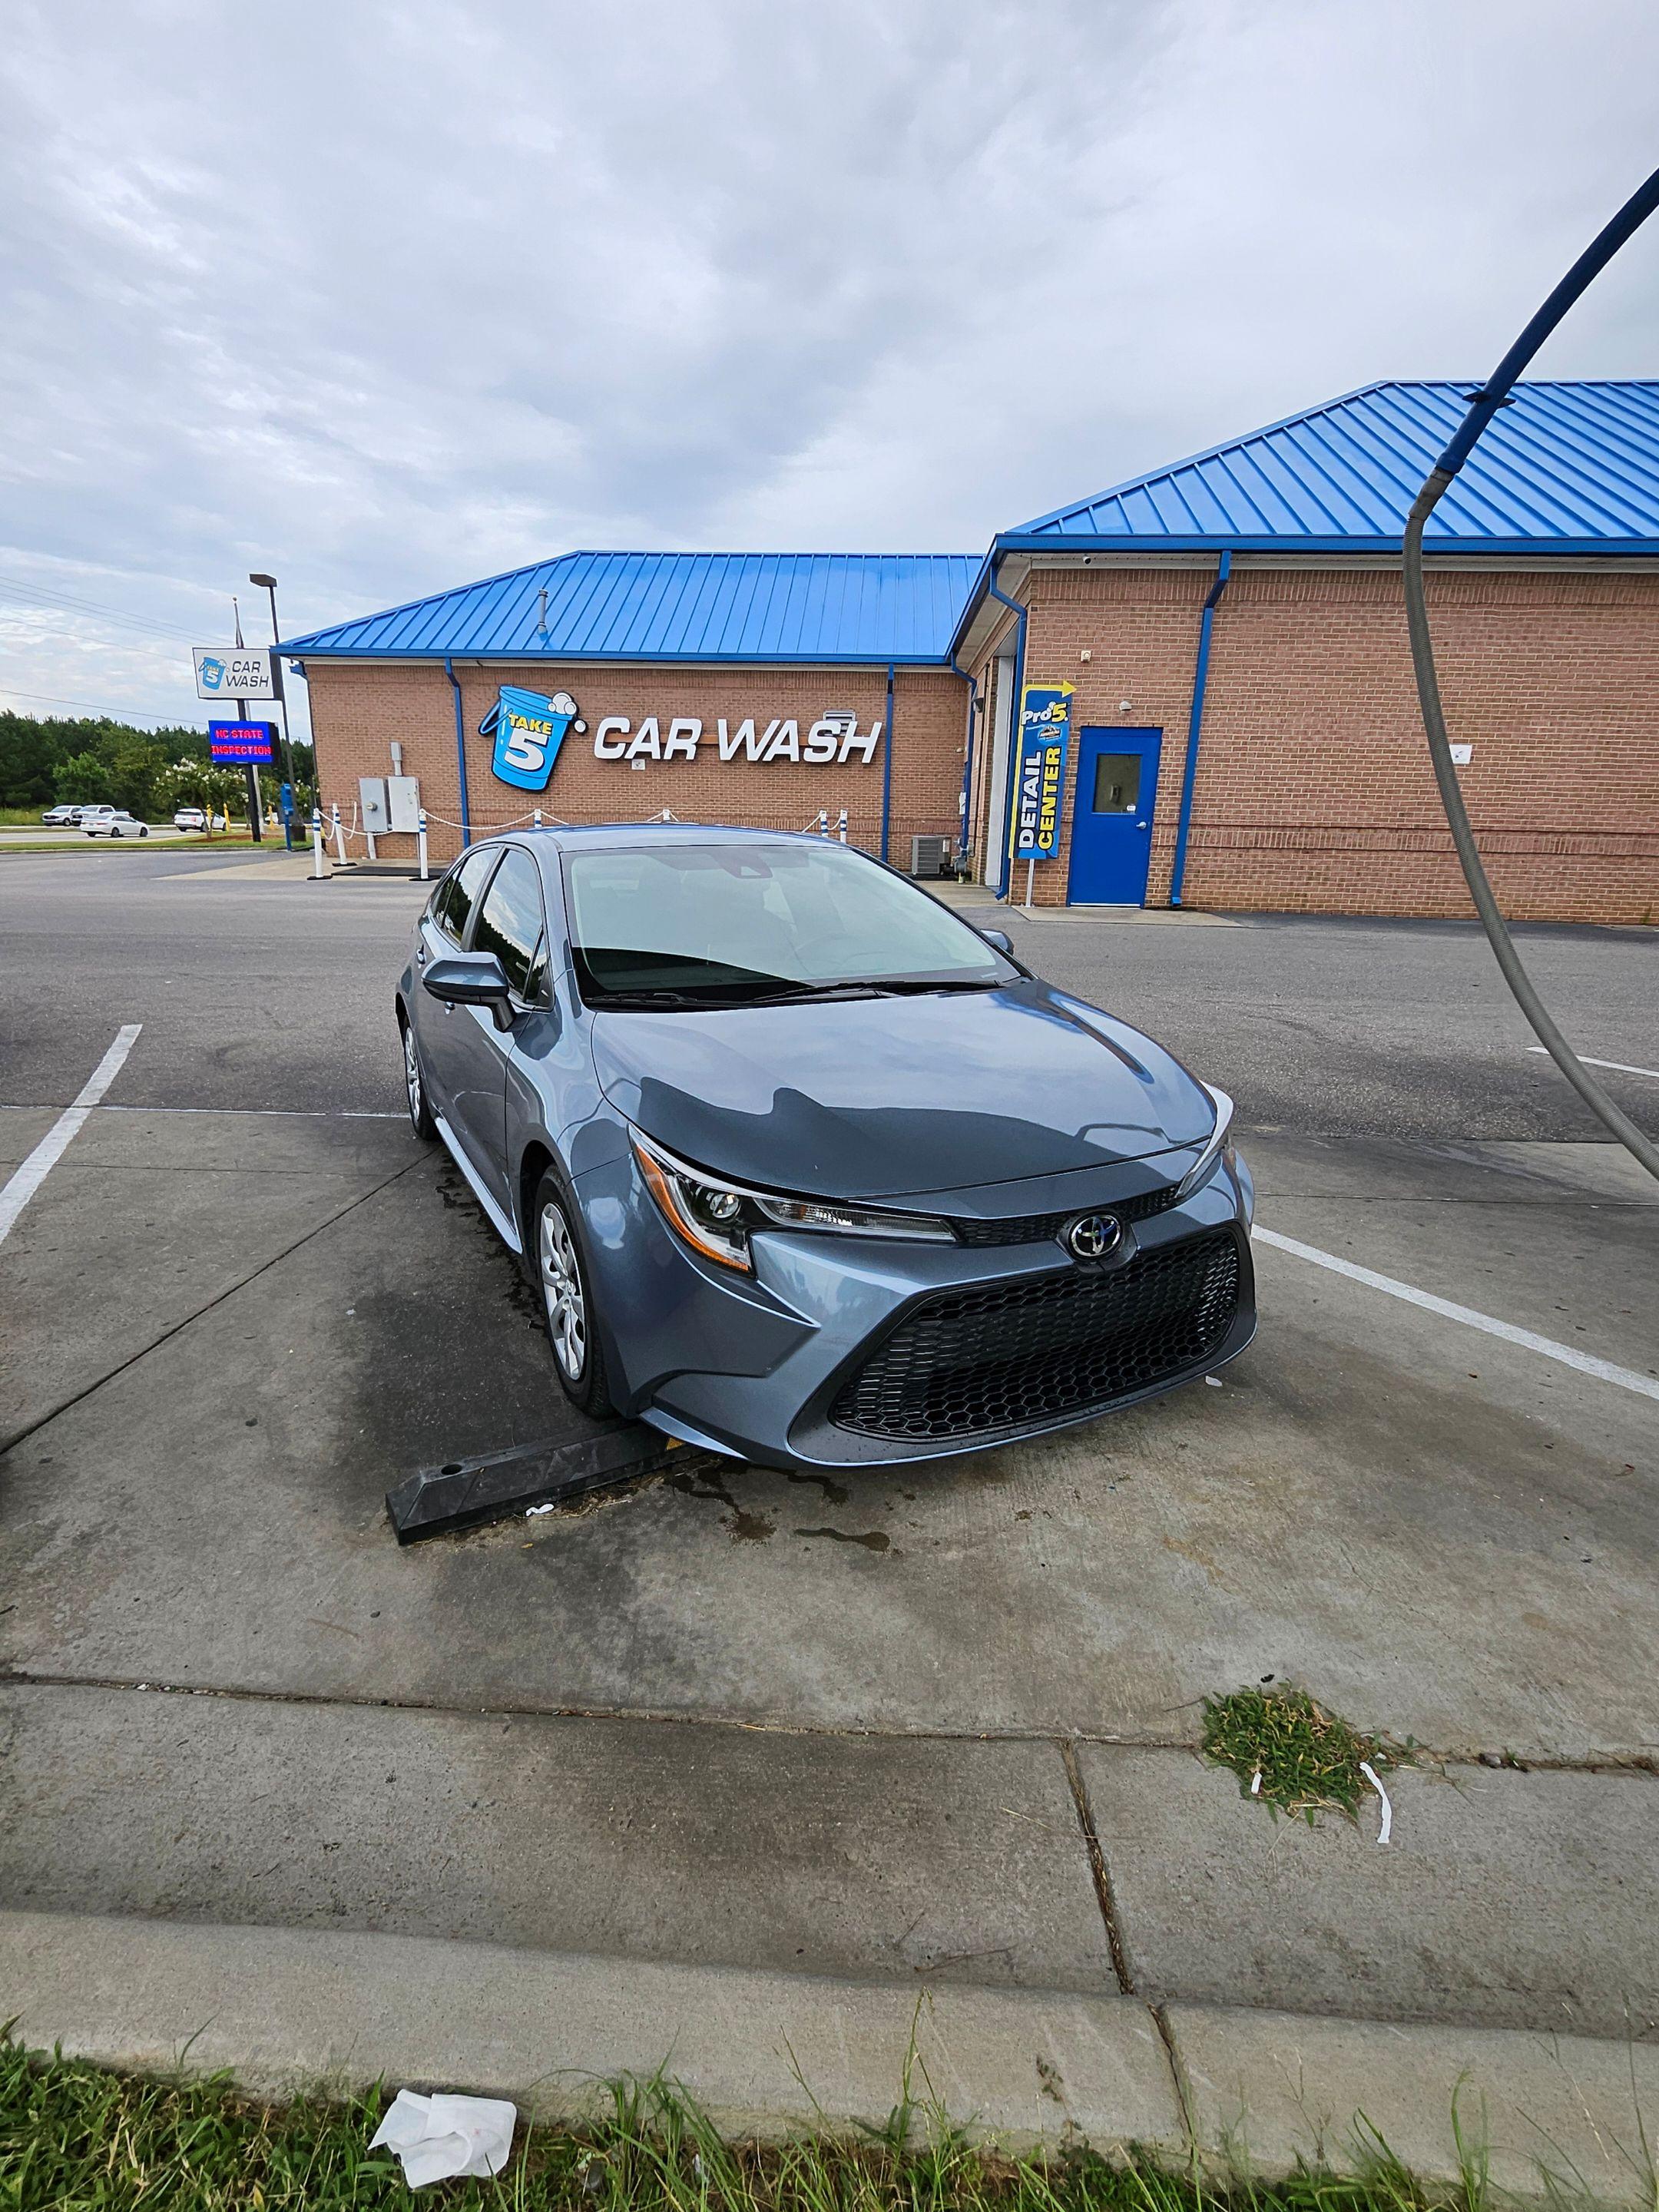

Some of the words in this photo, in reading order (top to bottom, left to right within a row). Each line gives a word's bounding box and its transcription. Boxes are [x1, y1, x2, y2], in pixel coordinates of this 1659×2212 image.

[232, 661, 261, 673] CAR
[206, 671, 219, 684] 5
[226, 675, 269, 687] WASH
[508, 714, 553, 735] TAKE
[215, 730, 229, 738] NC
[231, 730, 264, 739] STATE
[594, 717, 702, 760] CAR
[717, 718, 882, 763] WASH
[211, 745, 271, 755] INSPECTION
[504, 727, 548, 770] 5
[1018, 751, 1041, 848] DETAIL
[1038, 747, 1061, 849] CENTER
